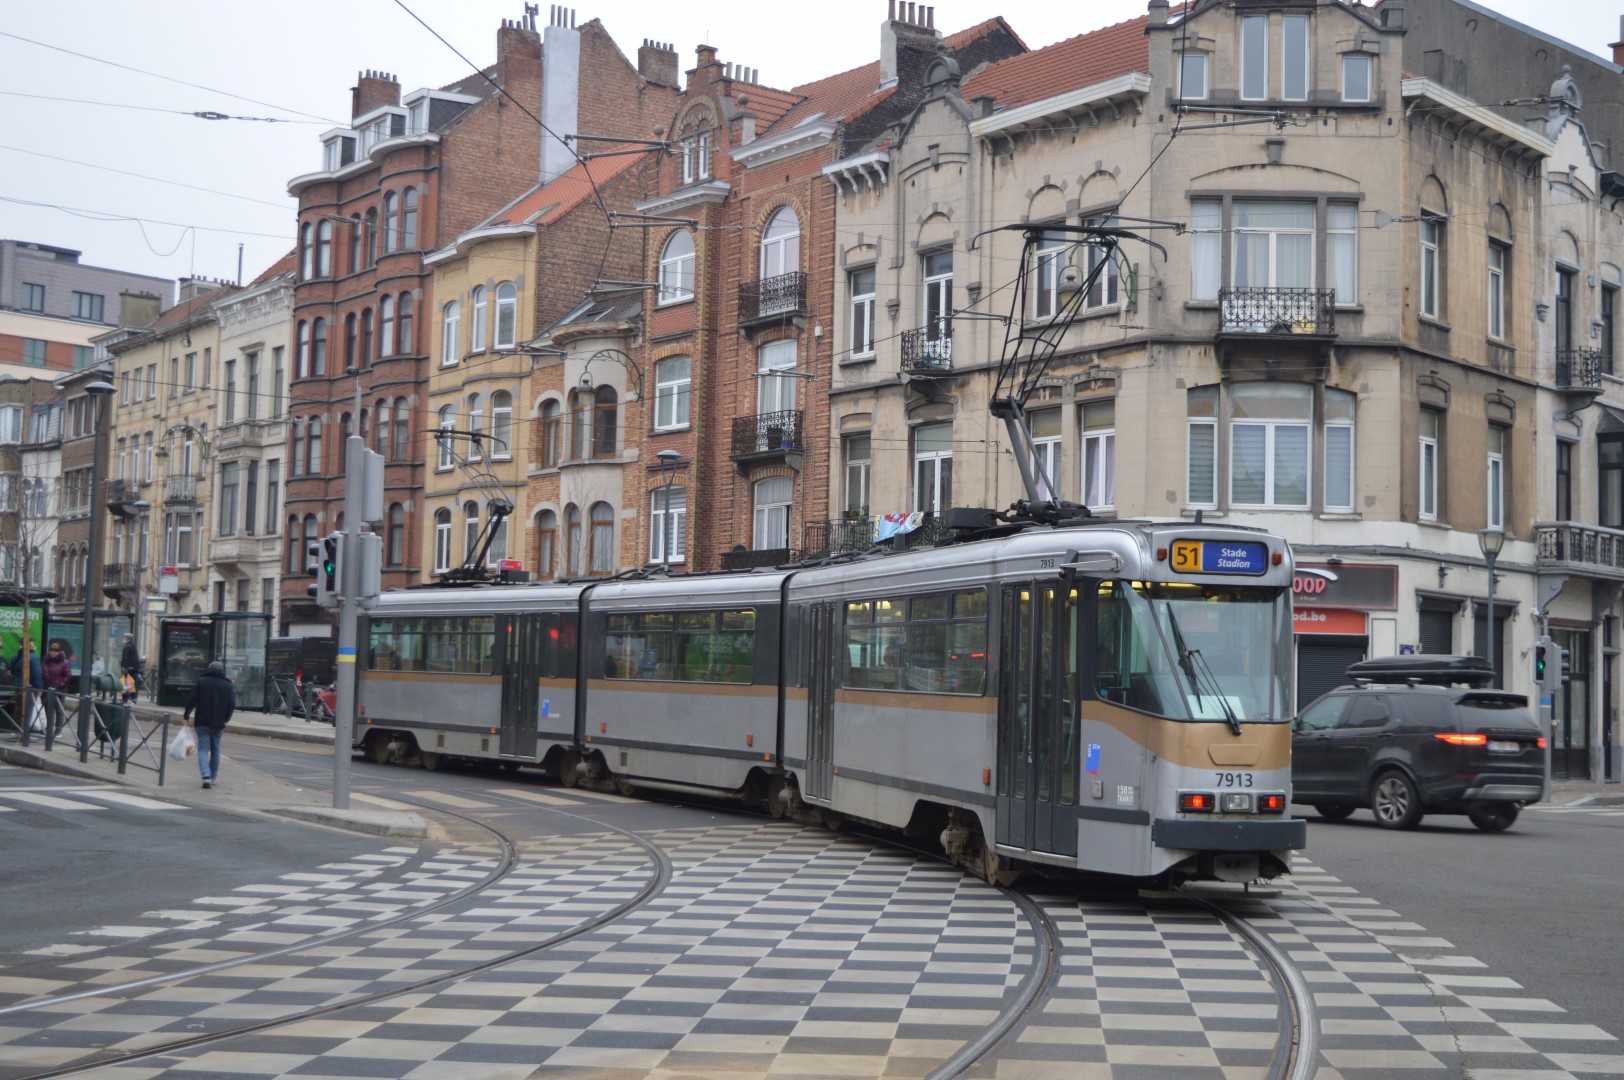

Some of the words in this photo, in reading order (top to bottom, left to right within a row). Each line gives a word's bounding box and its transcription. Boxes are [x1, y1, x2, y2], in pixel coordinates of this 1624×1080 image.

[1176, 546, 1199, 567] 51
[1221, 548, 1247, 558] Stade
[1040, 558, 1055, 569] 7913
[1217, 558, 1250, 569] Stadion
[1215, 772, 1253, 788] 7913
[1117, 785, 1128, 795] 150
